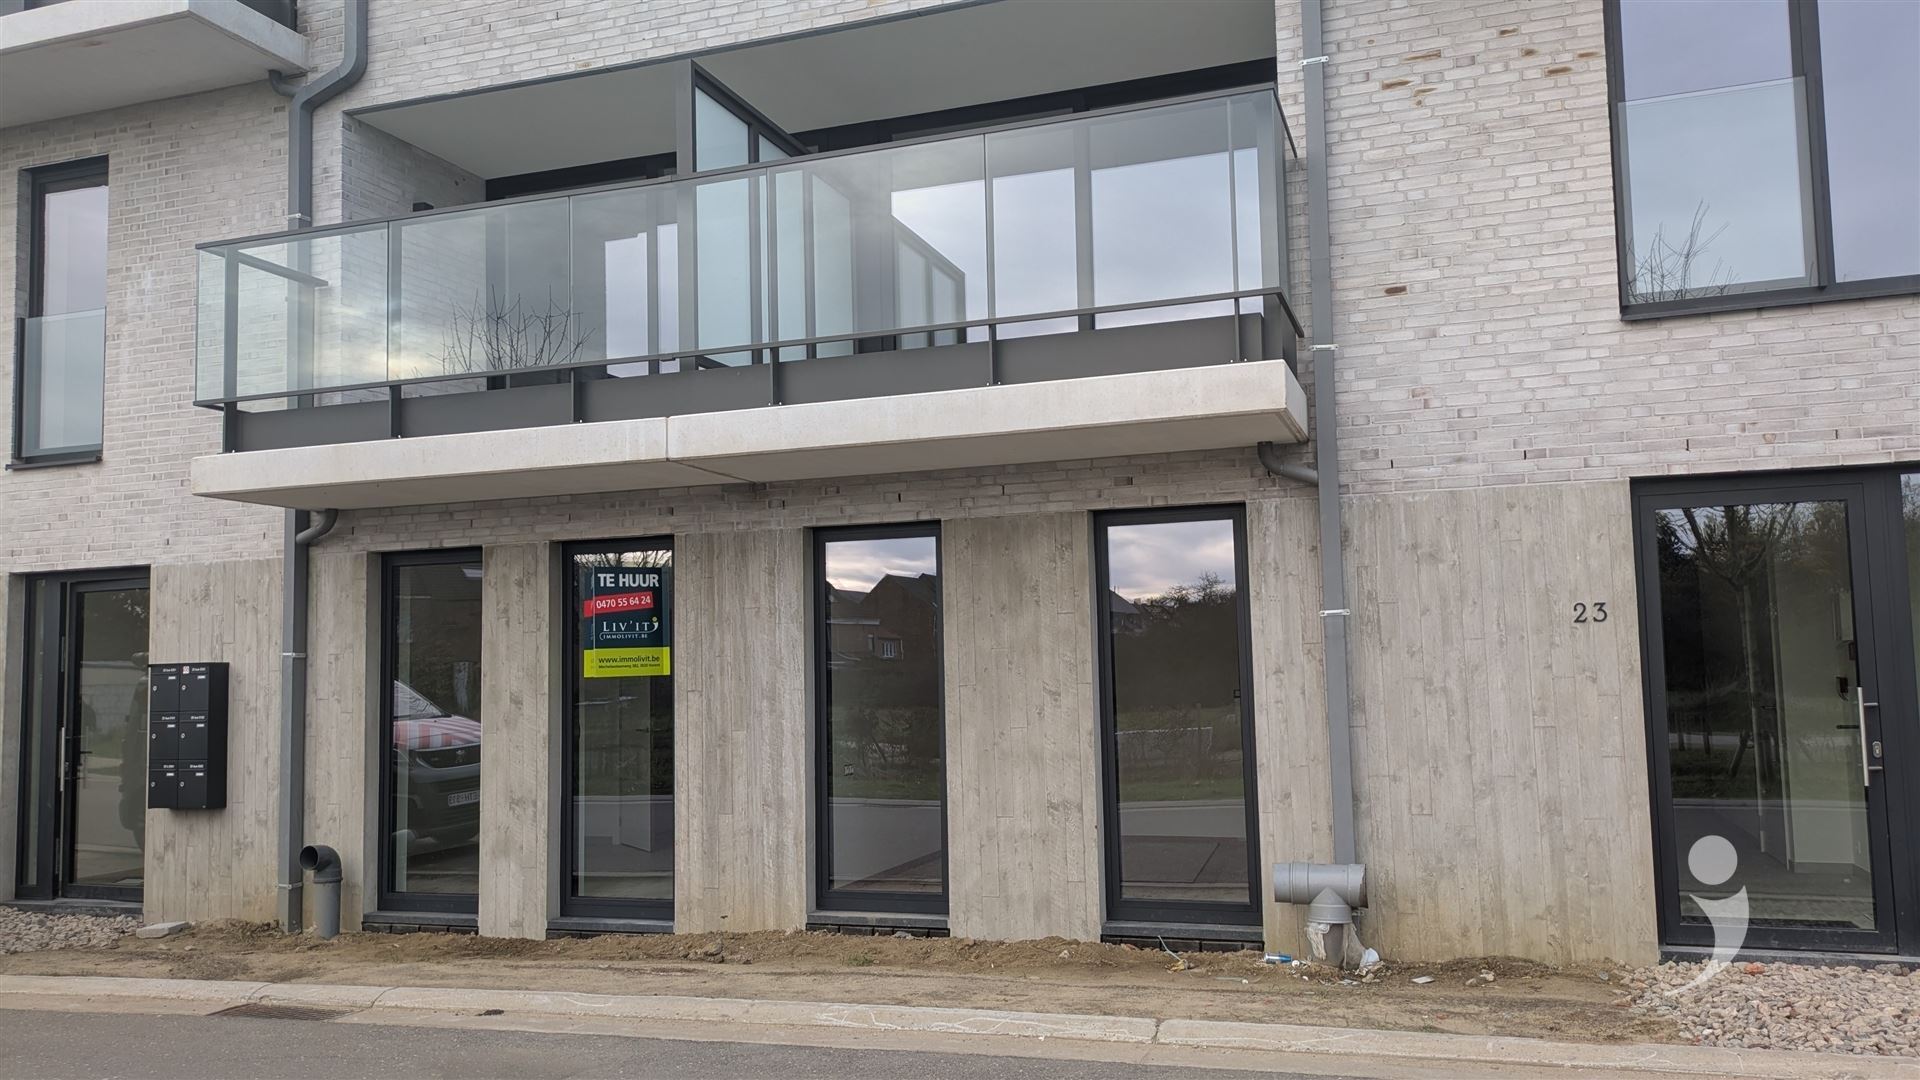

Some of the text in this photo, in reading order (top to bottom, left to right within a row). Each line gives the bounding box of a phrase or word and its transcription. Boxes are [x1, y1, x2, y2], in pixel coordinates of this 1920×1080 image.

[597, 573, 660, 588] TE HUUR
[596, 595, 651, 609] 0470 55 64 24
[1573, 602, 1608, 623] 23
[598, 655, 660, 664] www.immolivit.be
